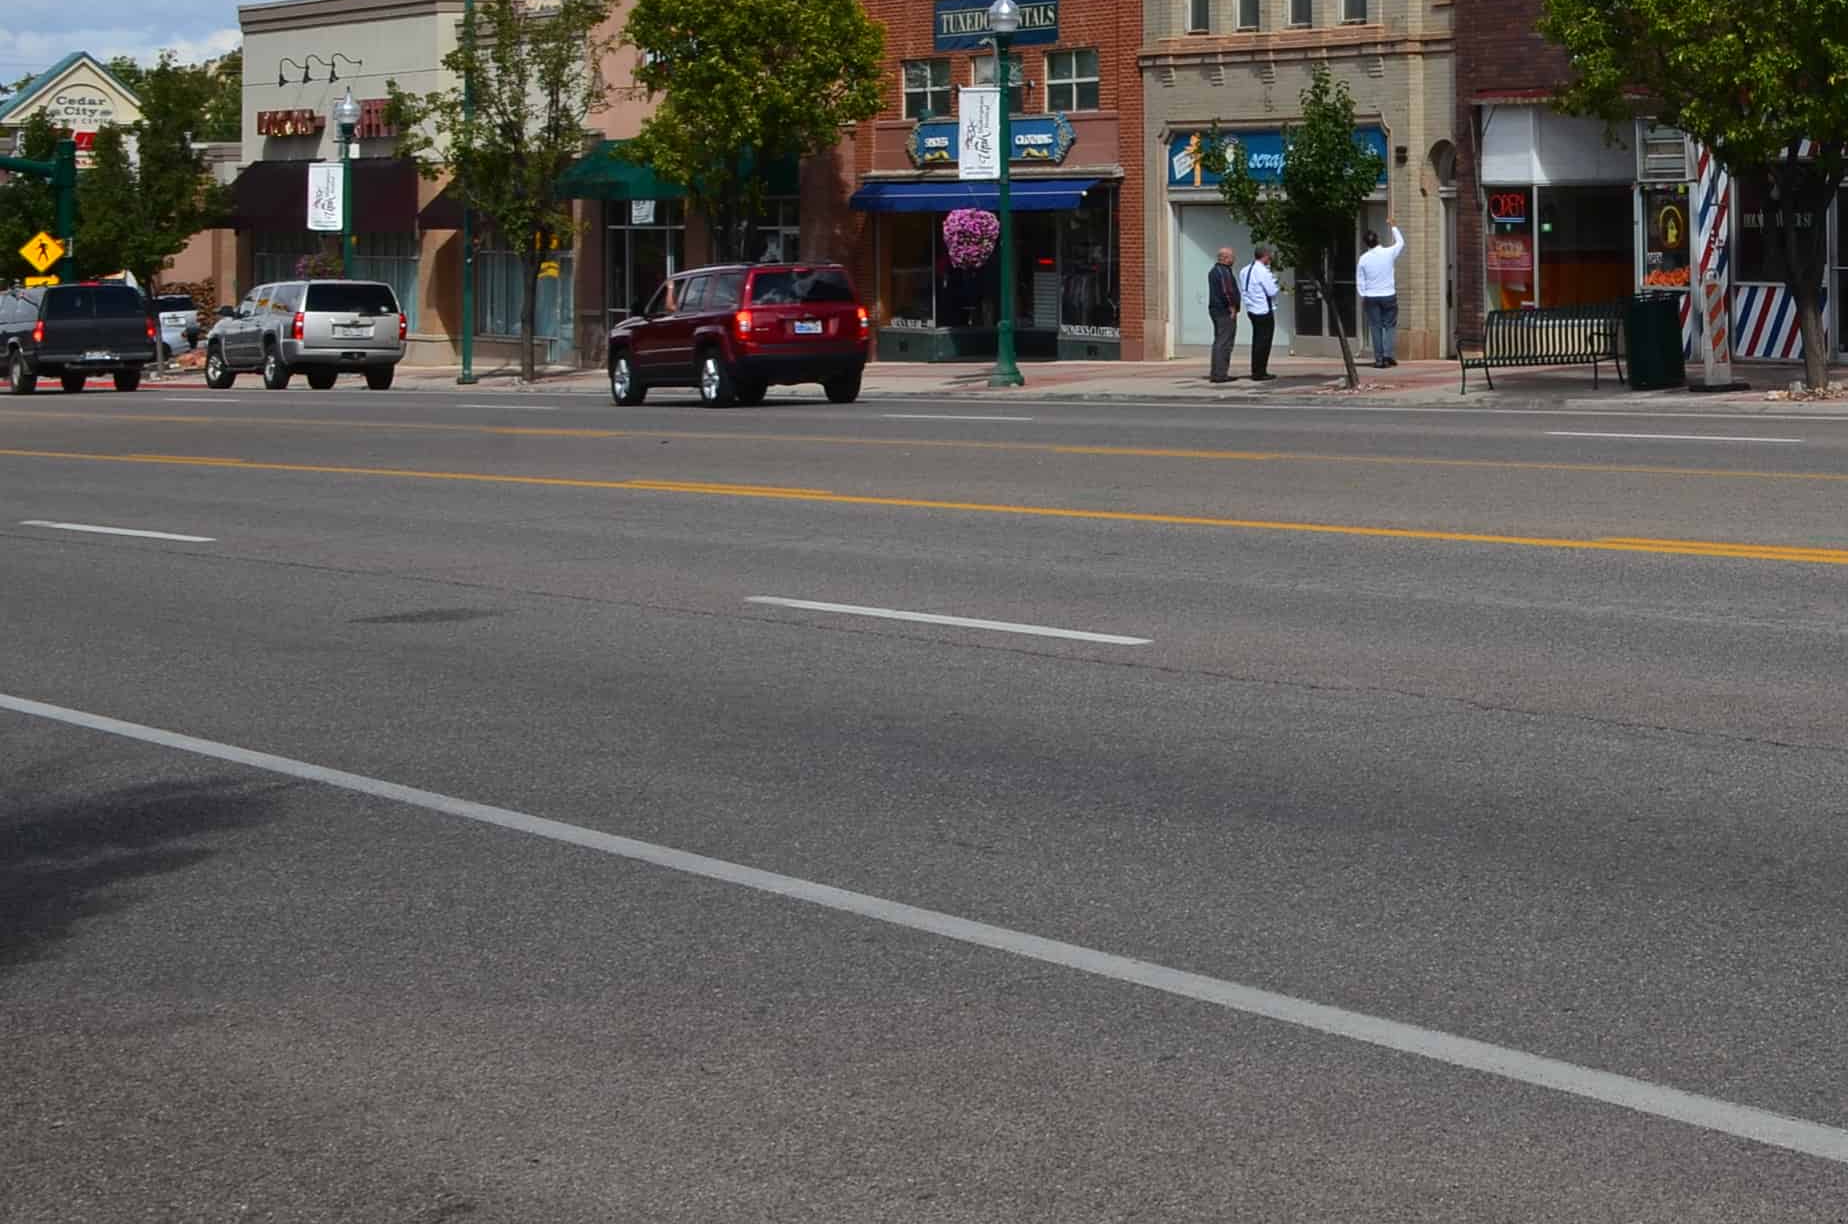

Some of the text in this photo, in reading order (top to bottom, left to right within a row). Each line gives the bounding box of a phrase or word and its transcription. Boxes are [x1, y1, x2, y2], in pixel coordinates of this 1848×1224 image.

[55, 96, 107, 106] Cedar
[64, 106, 99, 118] City
[1490, 193, 1525, 217] OPEN
